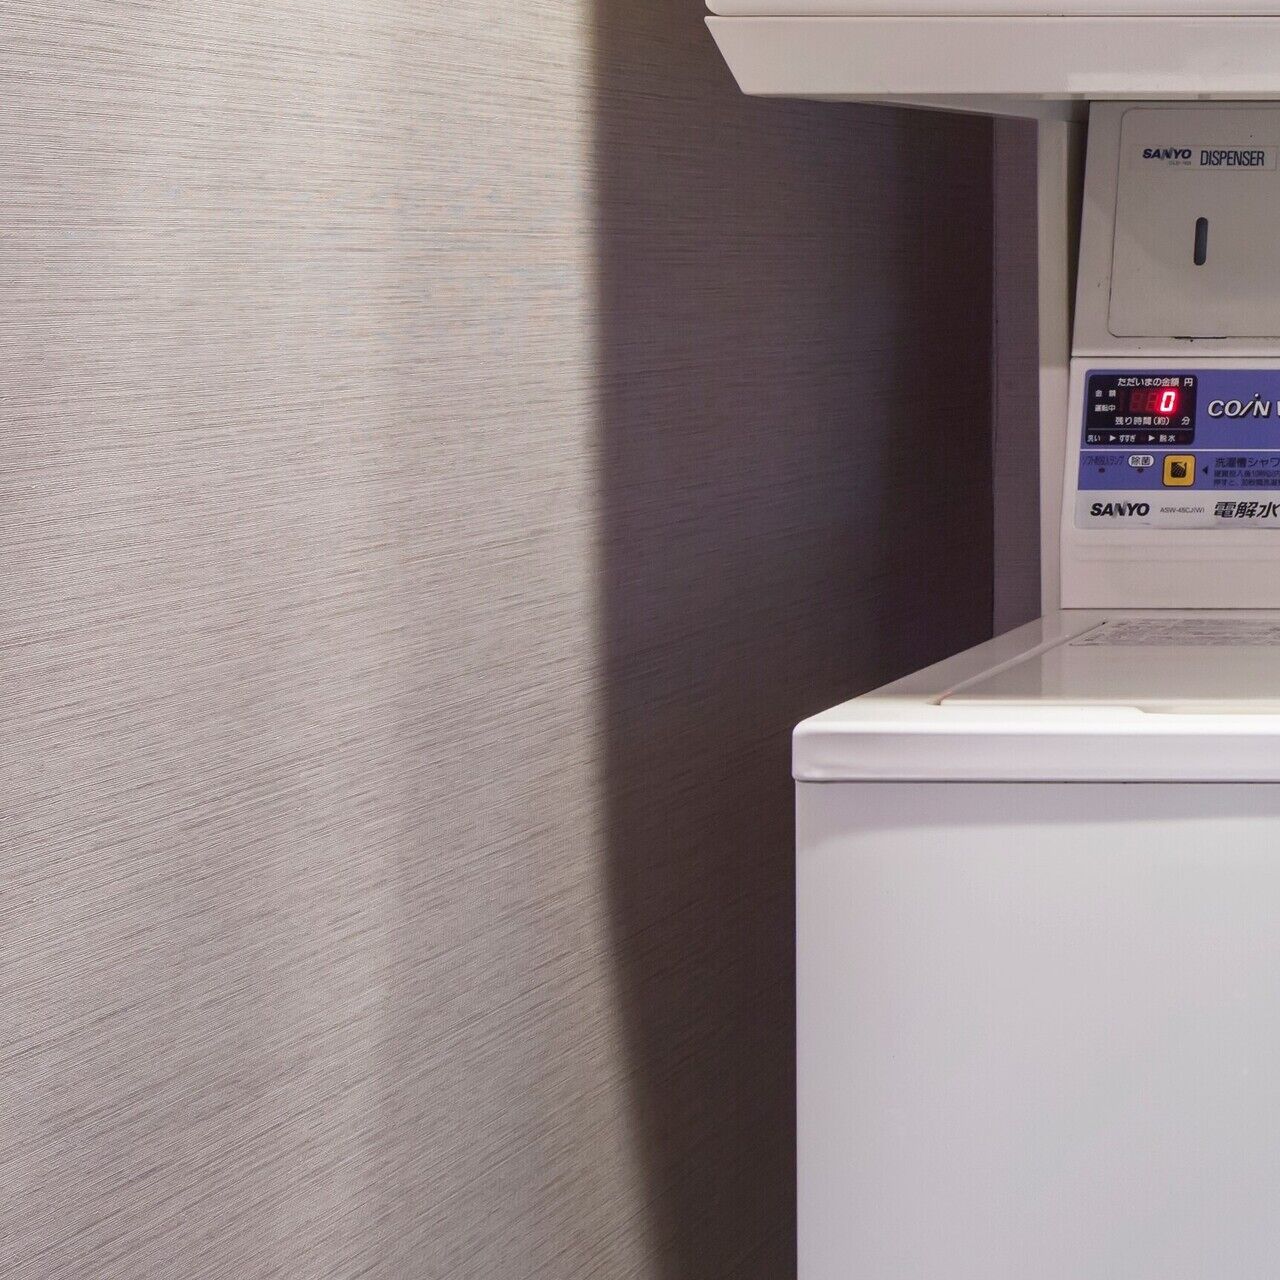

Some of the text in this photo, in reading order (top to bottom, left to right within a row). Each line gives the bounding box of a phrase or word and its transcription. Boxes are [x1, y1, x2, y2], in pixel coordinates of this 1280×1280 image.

[1143, 148, 1264, 166] SANYO DISPENSER
[1118, 378, 1179, 386] ただいまの金額
[1160, 392, 1175, 411] 0
[1090, 500, 1150, 518] SANYO
